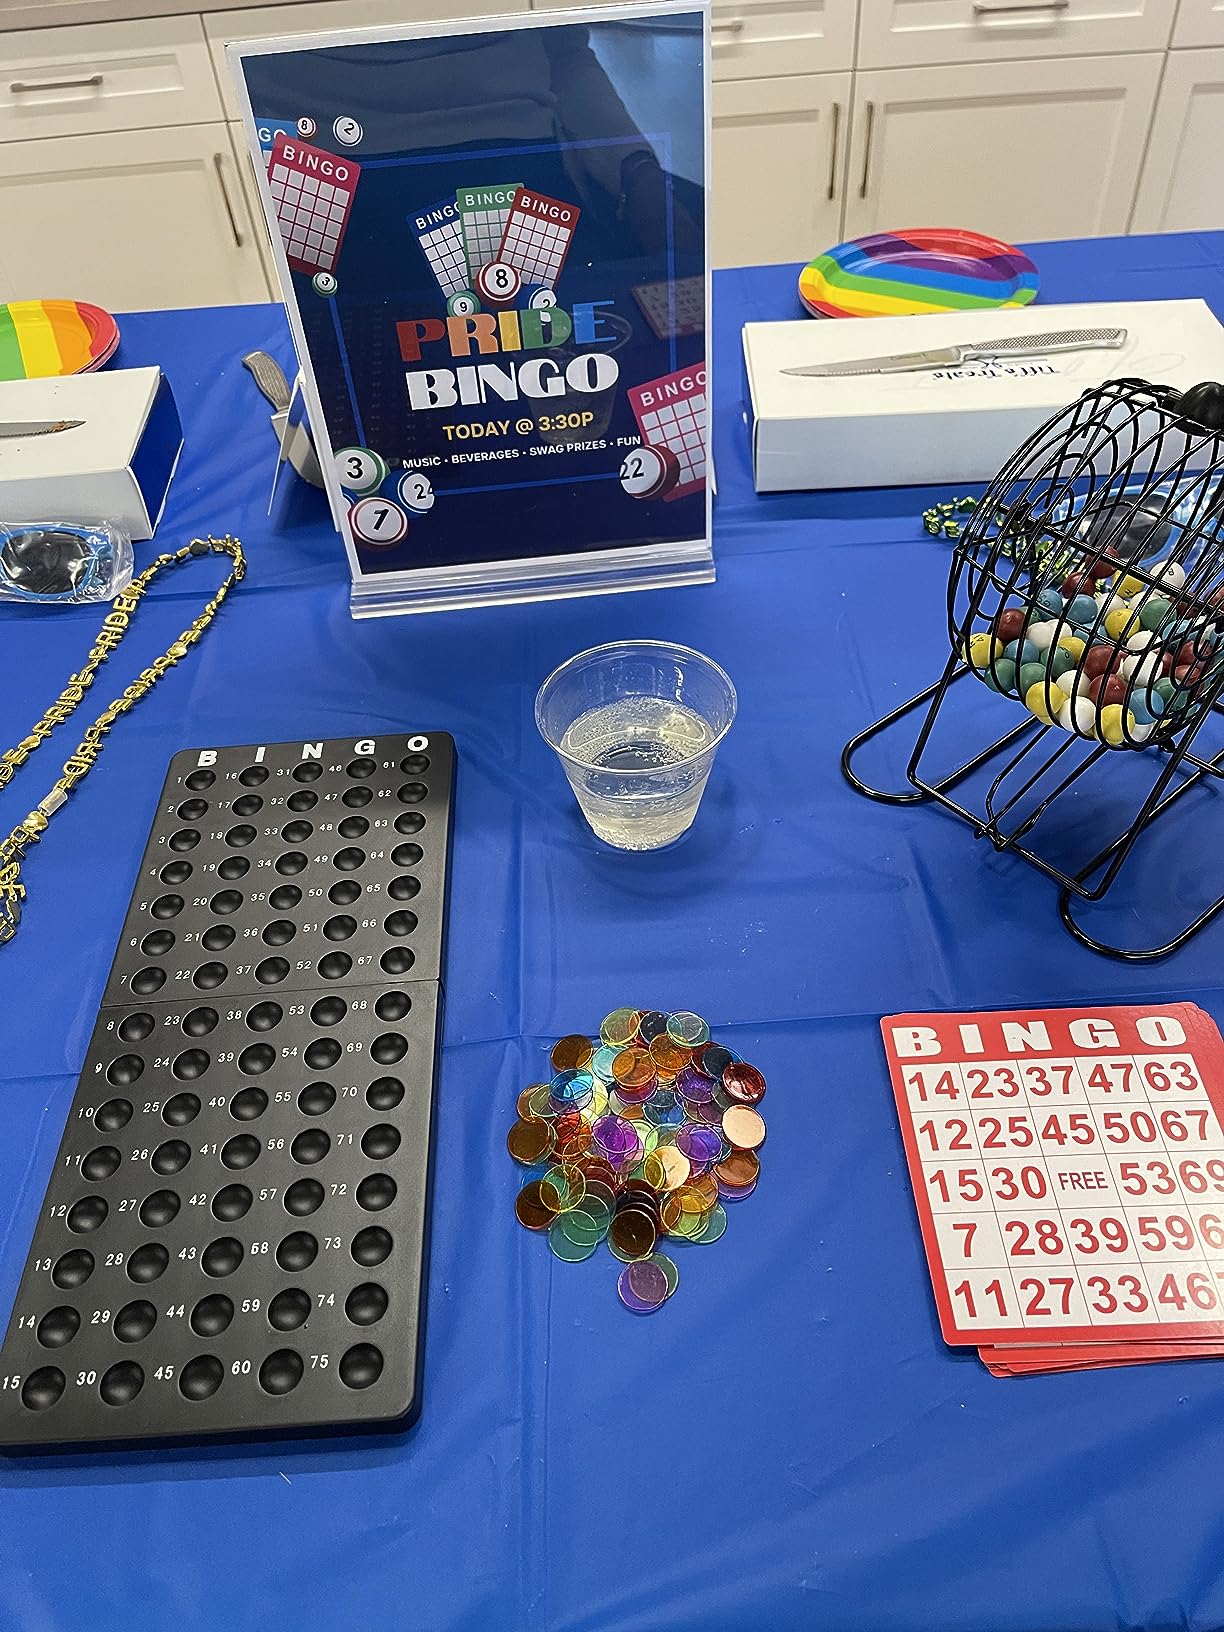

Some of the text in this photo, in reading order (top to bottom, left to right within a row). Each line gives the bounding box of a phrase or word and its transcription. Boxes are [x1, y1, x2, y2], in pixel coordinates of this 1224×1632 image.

[301, 119, 308, 130] 8
[344, 123, 355, 135] 2
[282, 145, 349, 181] BINGO
[465, 190, 516, 207] BINGO
[520, 195, 572, 222] BINGO
[321, 277, 331, 287] 3
[495, 269, 509, 288] 8
[459, 302, 468, 312] 9
[395, 300, 617, 362] PRIDE
[405, 353, 620, 411] BINGO
[640, 371, 707, 407] BINGO
[443, 411, 594, 441] TODAY @ 3:30P
[402, 436, 641, 469] MUSIC BEVERAGES SWAG PRIZES FUN
[346, 457, 364, 479] 3
[413, 483, 431, 500] 2
[373, 508, 390, 531] 1
[197, 736, 428, 766] B I N G O
[225, 772, 237, 780] 16
[271, 797, 284, 805] 32
[325, 793, 337, 801] 47
[319, 823, 333, 831] 48
[374, 819, 388, 827] 63
[202, 864, 215, 872] 19
[258, 859, 271, 868] 34
[314, 855, 328, 863] 49
[370, 851, 384, 859] 64
[193, 897, 208, 906] 20
[251, 892, 265, 902] 35
[308, 888, 323, 897] 50
[366, 883, 381, 892] 65
[184, 933, 199, 942] 21
[243, 928, 258, 937] 36
[303, 923, 317, 932] 51
[361, 919, 377, 928] 66
[175, 970, 190, 980] 22
[236, 966, 251, 974] 37
[296, 960, 311, 970] 52
[358, 956, 372, 965] 67
[164, 1016, 180, 1026] 23
[226, 1010, 242, 1021] 38
[288, 1005, 304, 1015] 53
[351, 1001, 367, 1010] 68
[154, 1058, 170, 1068] 24
[217, 1052, 234, 1063] 39
[282, 1048, 298, 1058] 54
[347, 1042, 362, 1053] 69
[909, 1062, 1198, 1101] 14 23 37 47 63
[78, 1086, 358, 1118] 10 25 40 55 70
[920, 1110, 1209, 1152] 12 25 45 50 67
[64, 1134, 353, 1166] 11 26 41 56 71
[930, 1169, 983, 1202] 15
[992, 1166, 1046, 1200] 30
[1058, 1172, 1109, 1191] FREE
[1119, 1162, 1176, 1195] 53
[50, 1184, 347, 1217] 12 27 42 57 72
[953, 1223, 978, 1257] 7
[1005, 1220, 1063, 1256] 28
[1070, 1218, 1128, 1253] 39
[1138, 1215, 1193, 1251] 59
[34, 1259, 52, 1271] 13
[105, 1253, 123, 1266] 28
[179, 1247, 196, 1260] 43
[325, 1237, 341, 1249] 73
[954, 1272, 1217, 1318] 11 27 33 46
[18, 1294, 335, 1328] 14 29 44 59 74
[2, 1355, 329, 1389] 15 30 45 60 75
